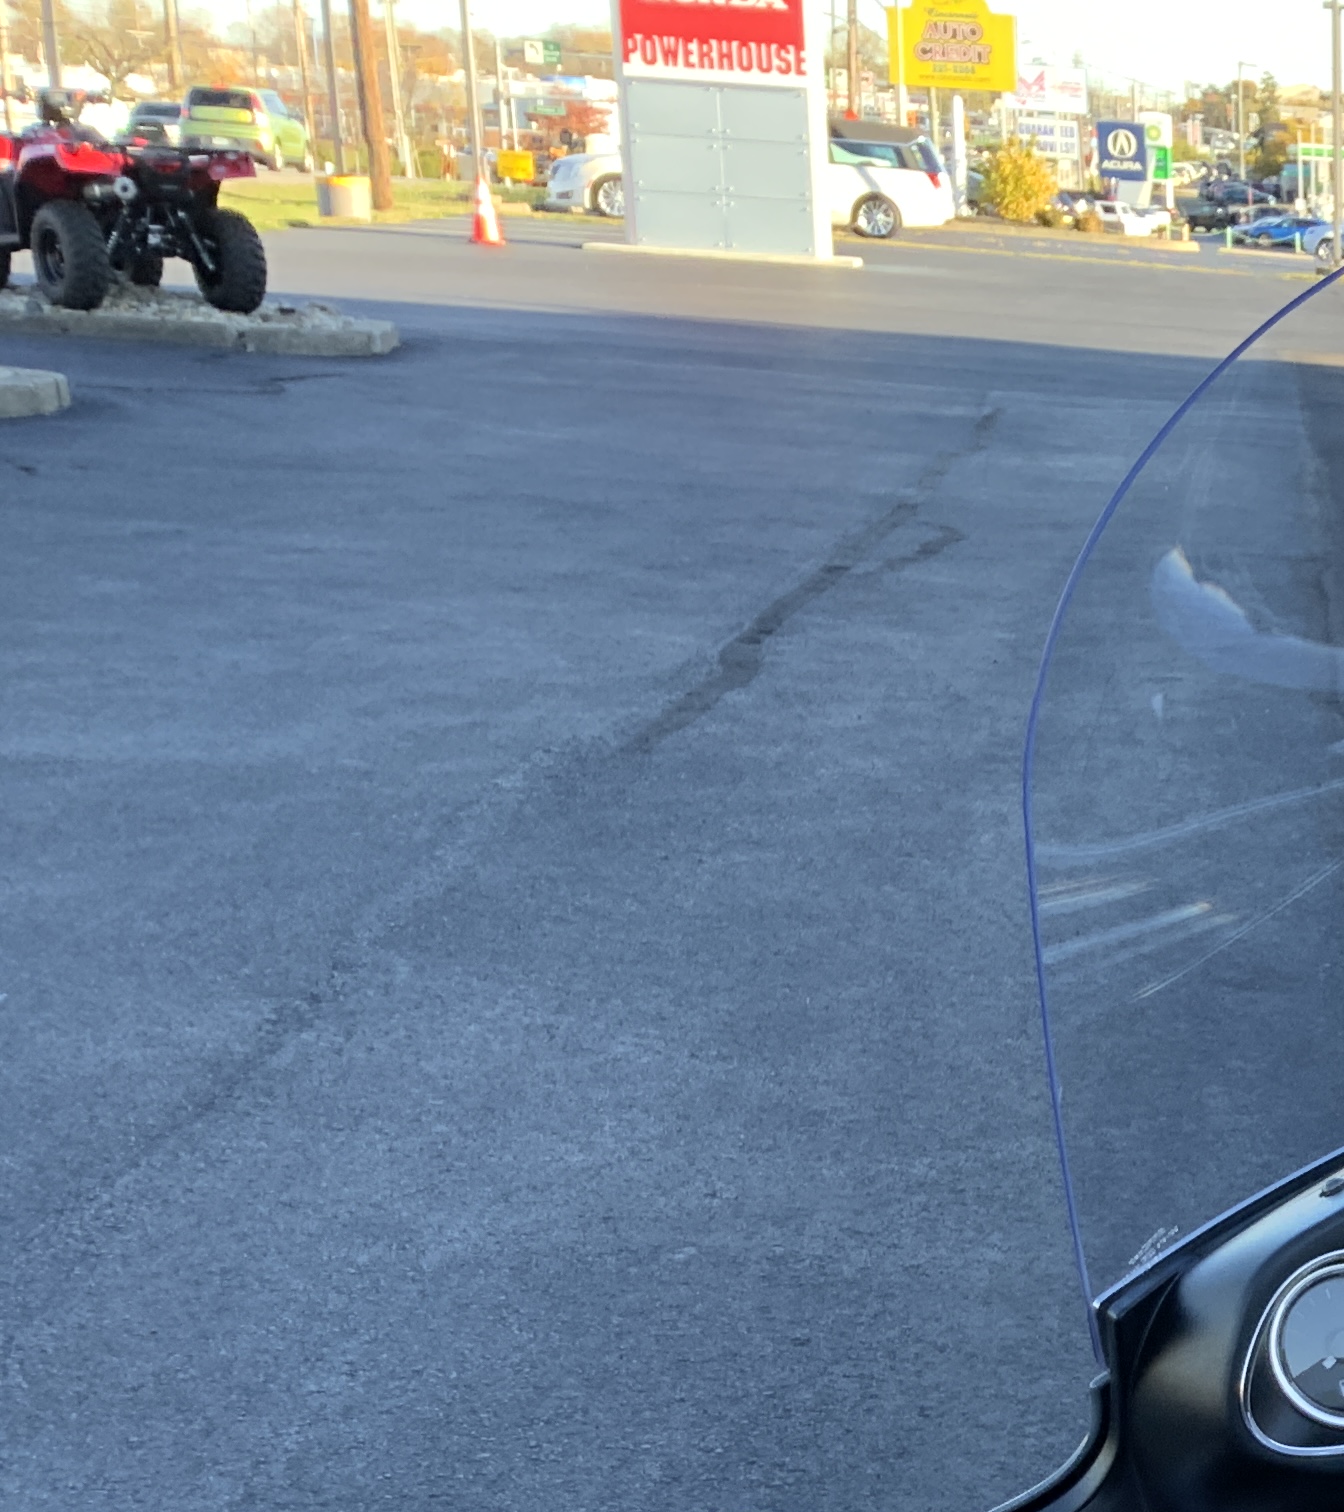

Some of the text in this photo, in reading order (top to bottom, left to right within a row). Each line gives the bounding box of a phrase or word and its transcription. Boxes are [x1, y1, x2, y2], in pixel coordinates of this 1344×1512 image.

[921, 20, 984, 41] AUTO
[623, 33, 807, 76] POWERHOUSE
[914, 41, 992, 65] CREDIT
[1101, 159, 1143, 171] ACURA
